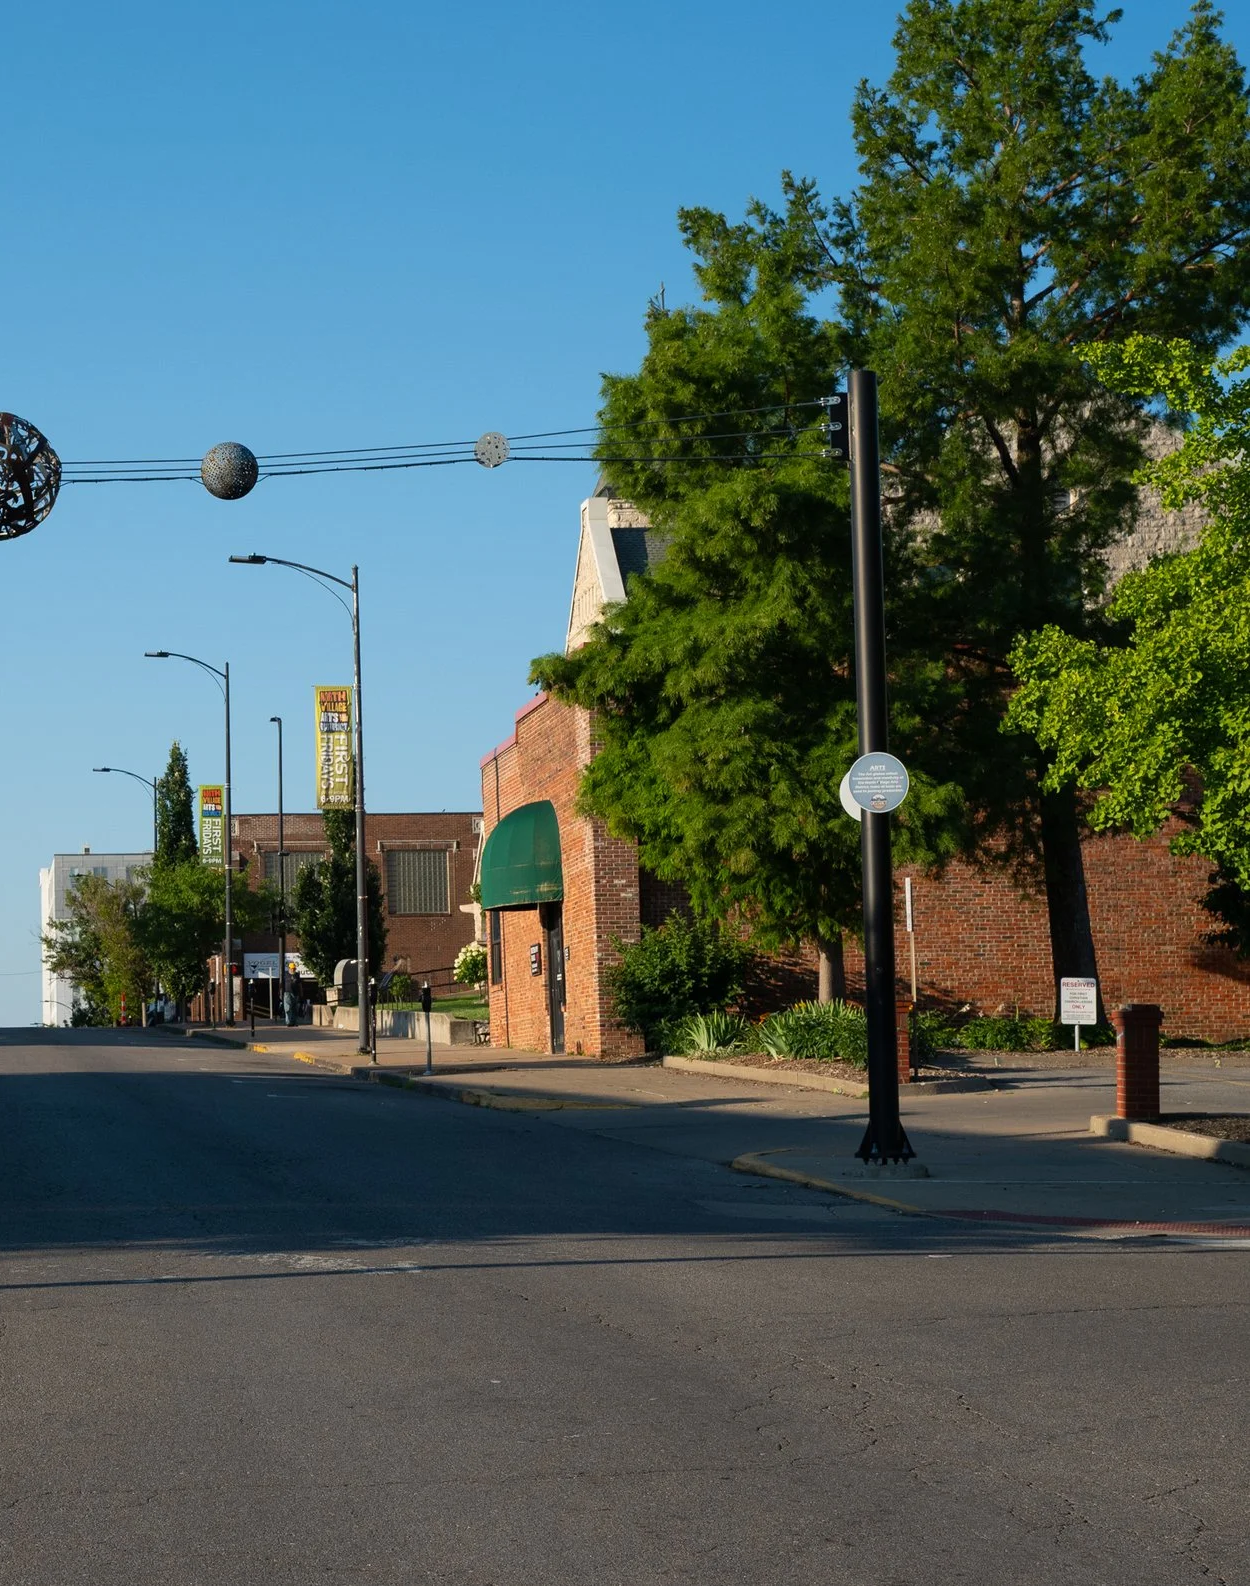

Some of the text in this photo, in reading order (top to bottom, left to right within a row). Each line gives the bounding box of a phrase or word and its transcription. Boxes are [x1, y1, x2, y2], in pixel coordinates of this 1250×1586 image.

[320, 734, 334, 789] FRIDAYS
[335, 734, 348, 786] FIRST
[202, 818, 212, 855] FRIDAYS
[212, 818, 221, 853] FIRST
